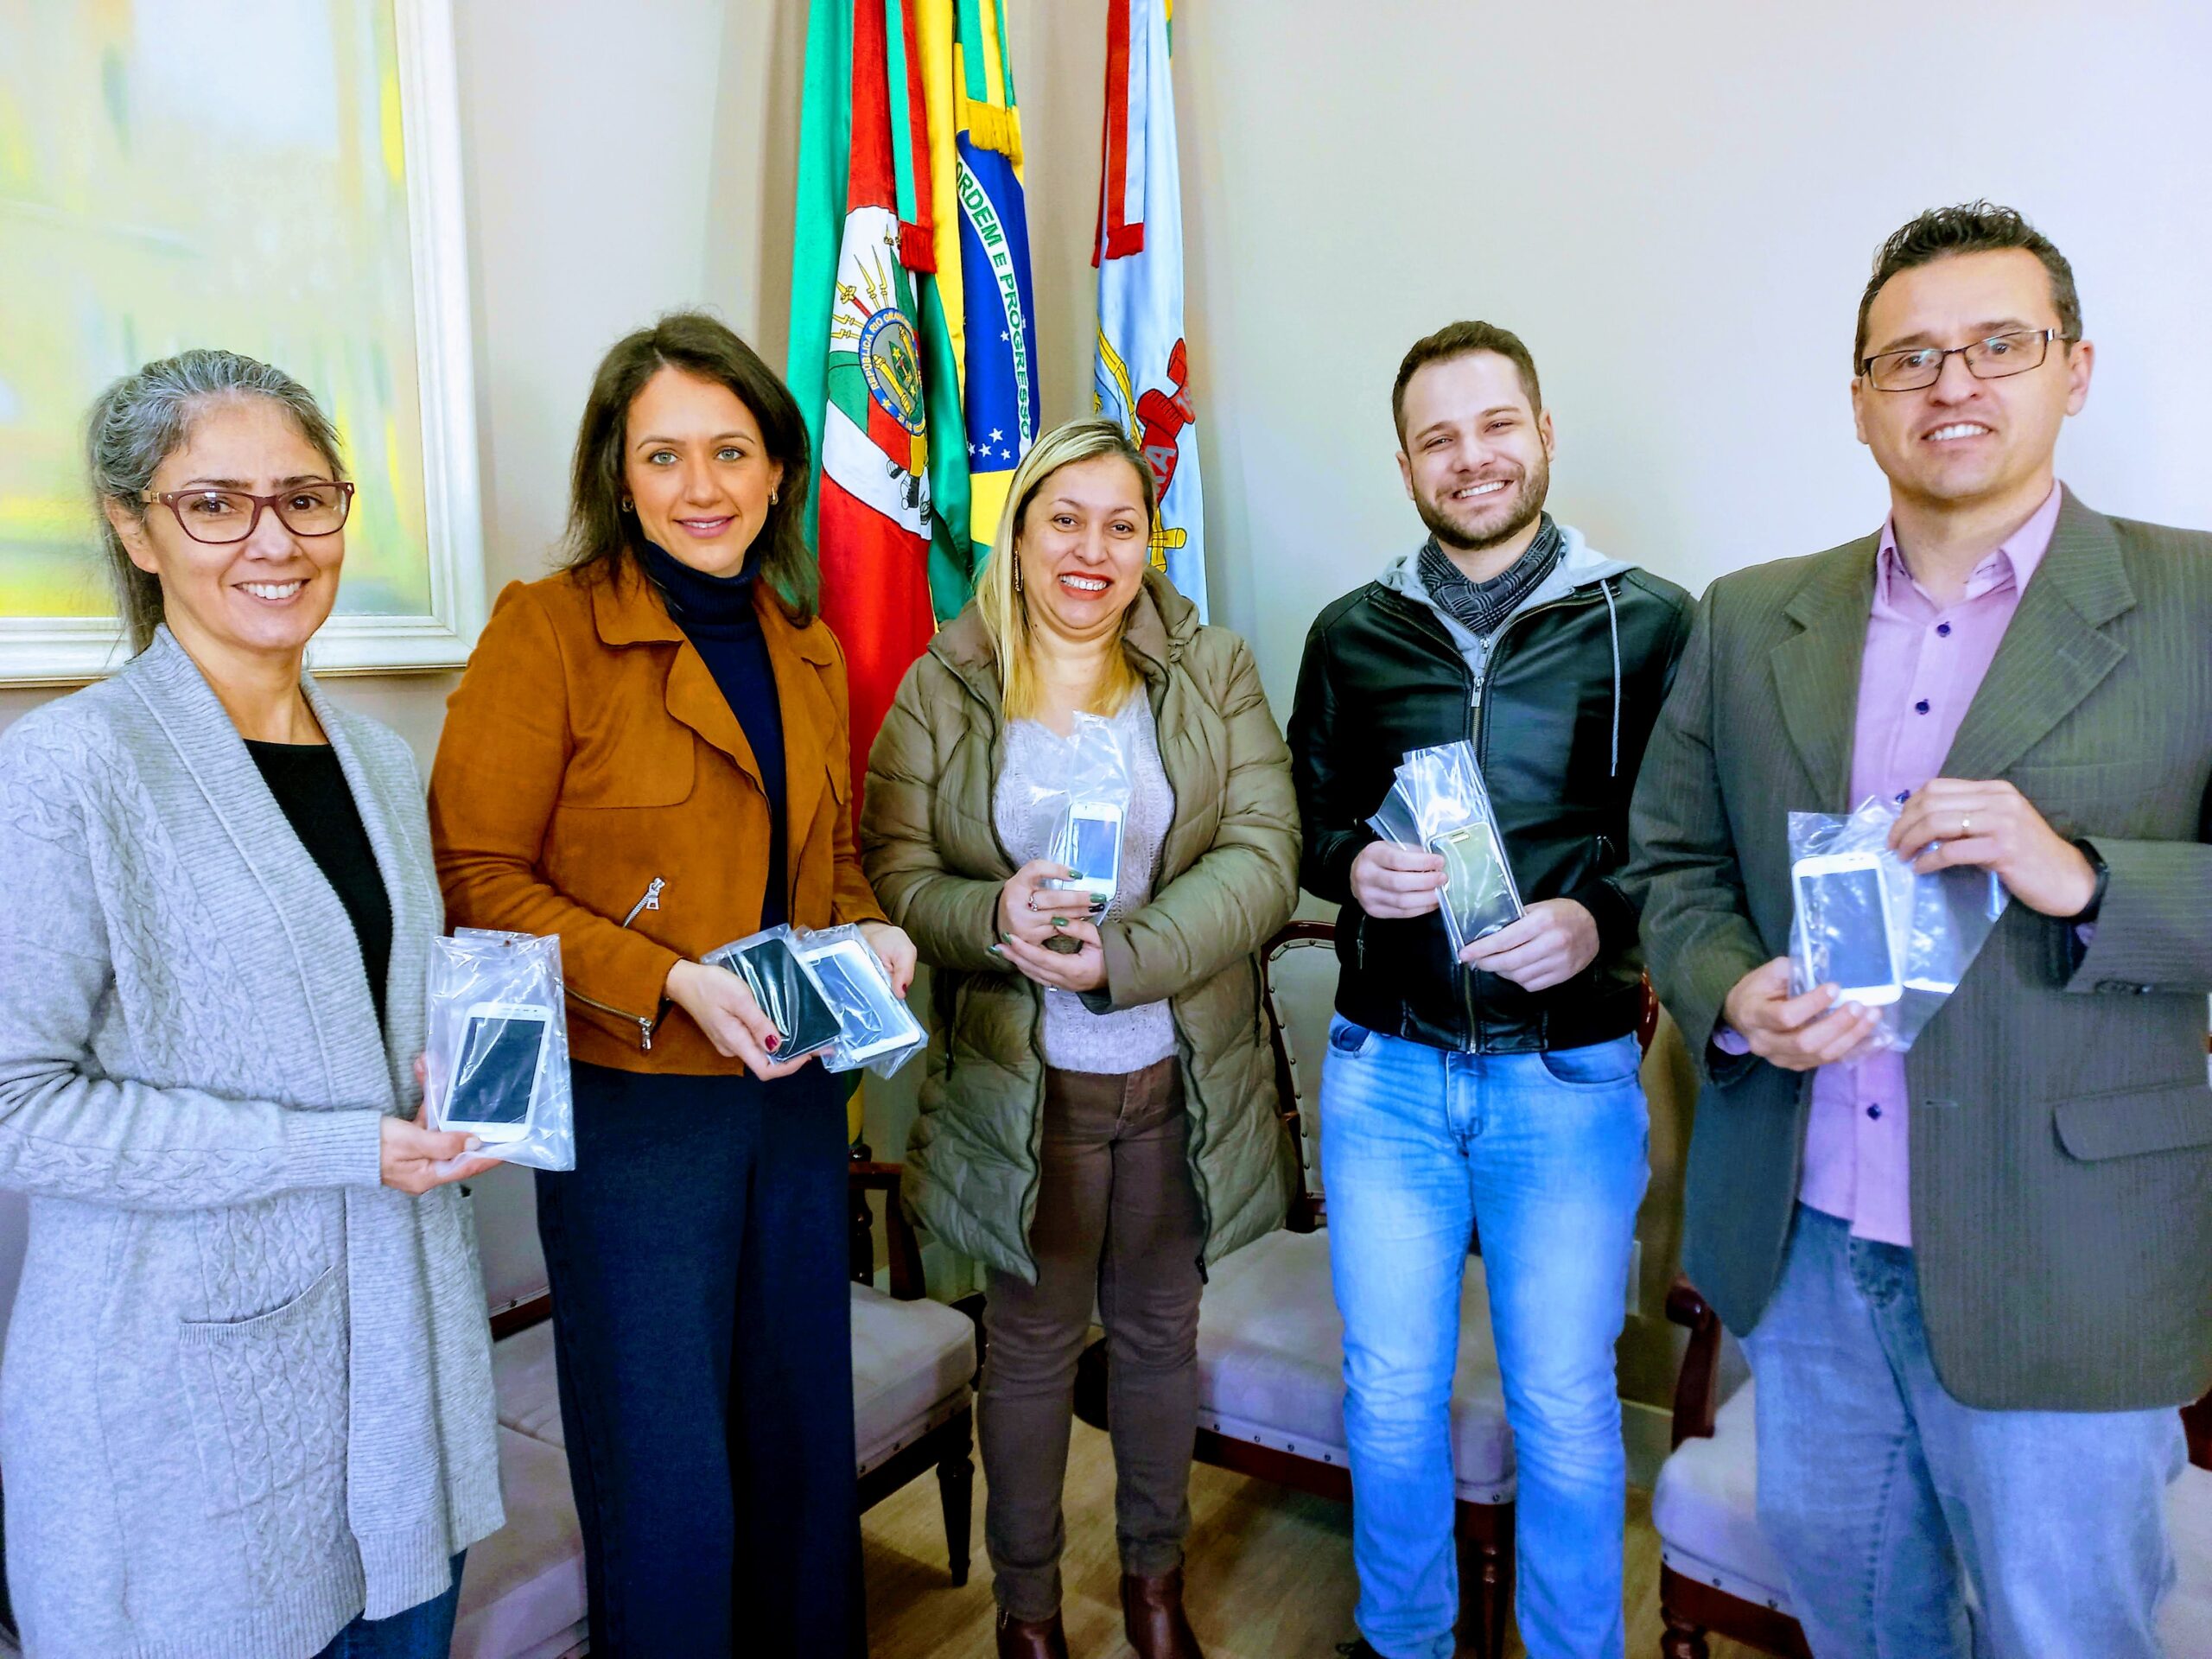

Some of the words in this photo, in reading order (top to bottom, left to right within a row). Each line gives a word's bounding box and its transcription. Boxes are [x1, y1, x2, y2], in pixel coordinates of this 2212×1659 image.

[868, 317, 884, 333] RIO
[957, 162, 1003, 248] ORDEM
[993, 252, 1007, 268] E
[1000, 272, 1029, 439] PROGRESSO
